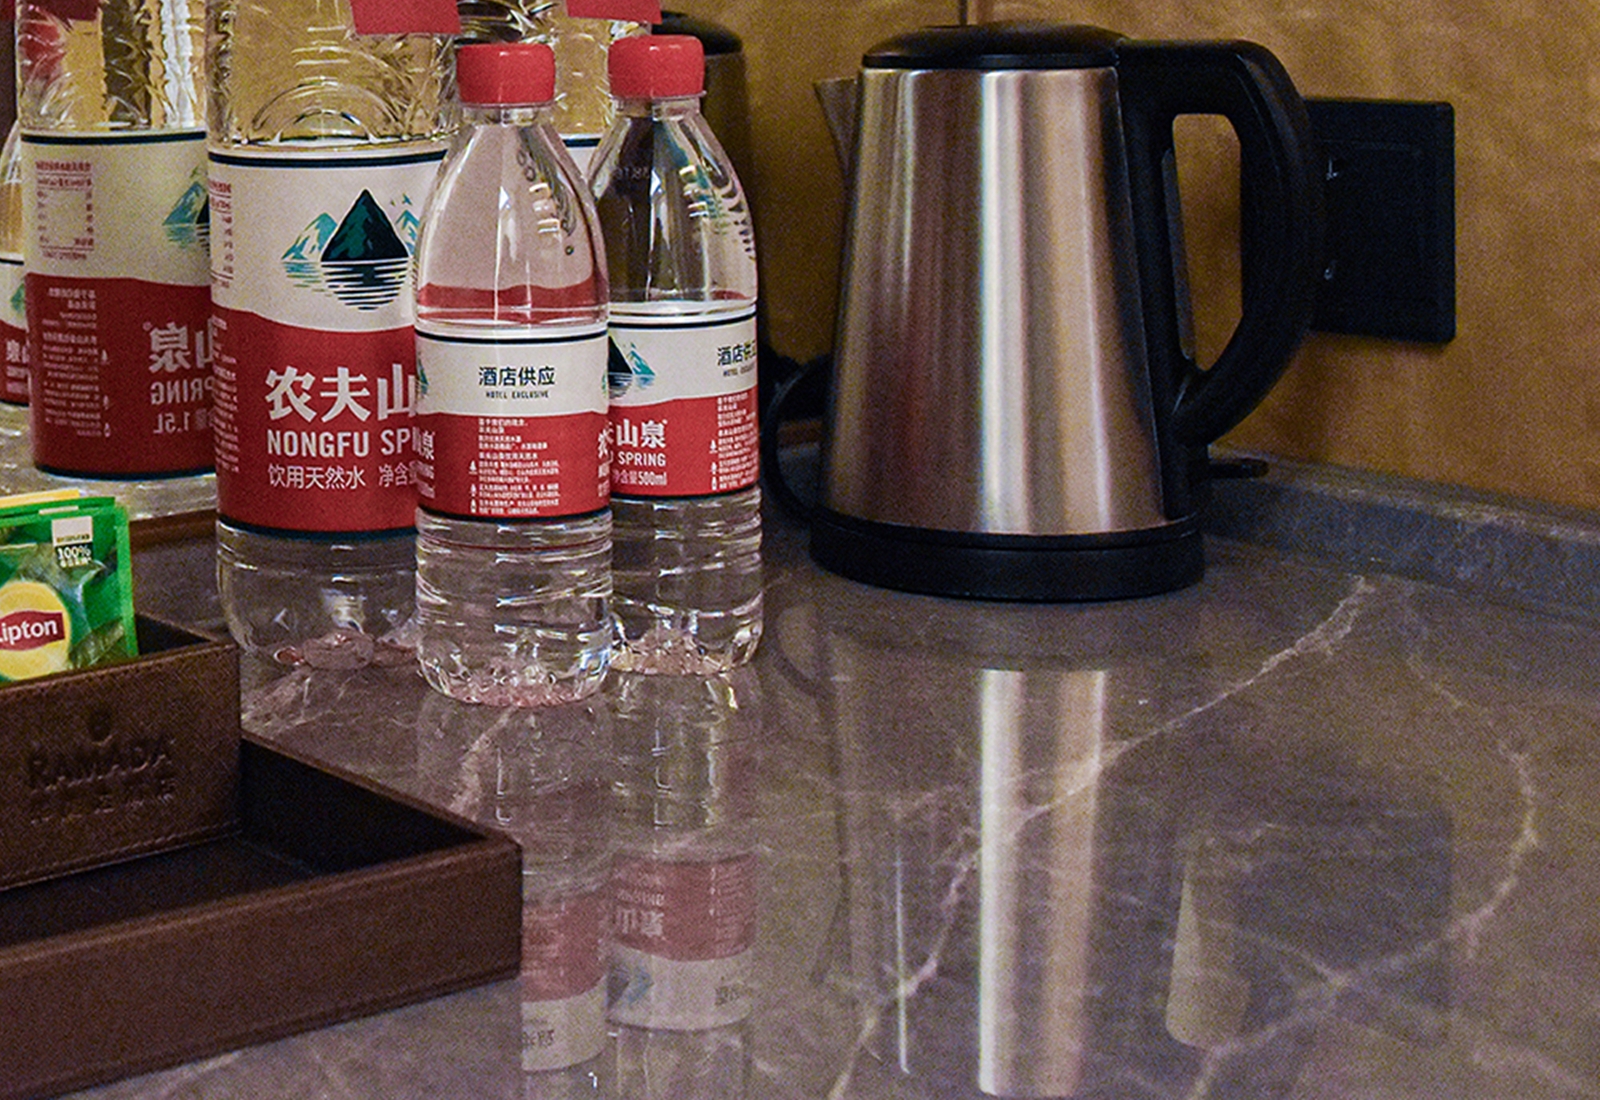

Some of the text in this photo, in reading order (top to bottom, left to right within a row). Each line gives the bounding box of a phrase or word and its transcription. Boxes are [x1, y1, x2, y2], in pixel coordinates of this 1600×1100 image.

[479, 366, 555, 386] 酒店供应
[486, 390, 549, 399] HOTEL EXCLUSIVE
[267, 428, 419, 458] NONGFU SP
[618, 451, 666, 467] SPRING
[267, 463, 366, 490] 饮用天然水
[57, 545, 91, 560] 100%
